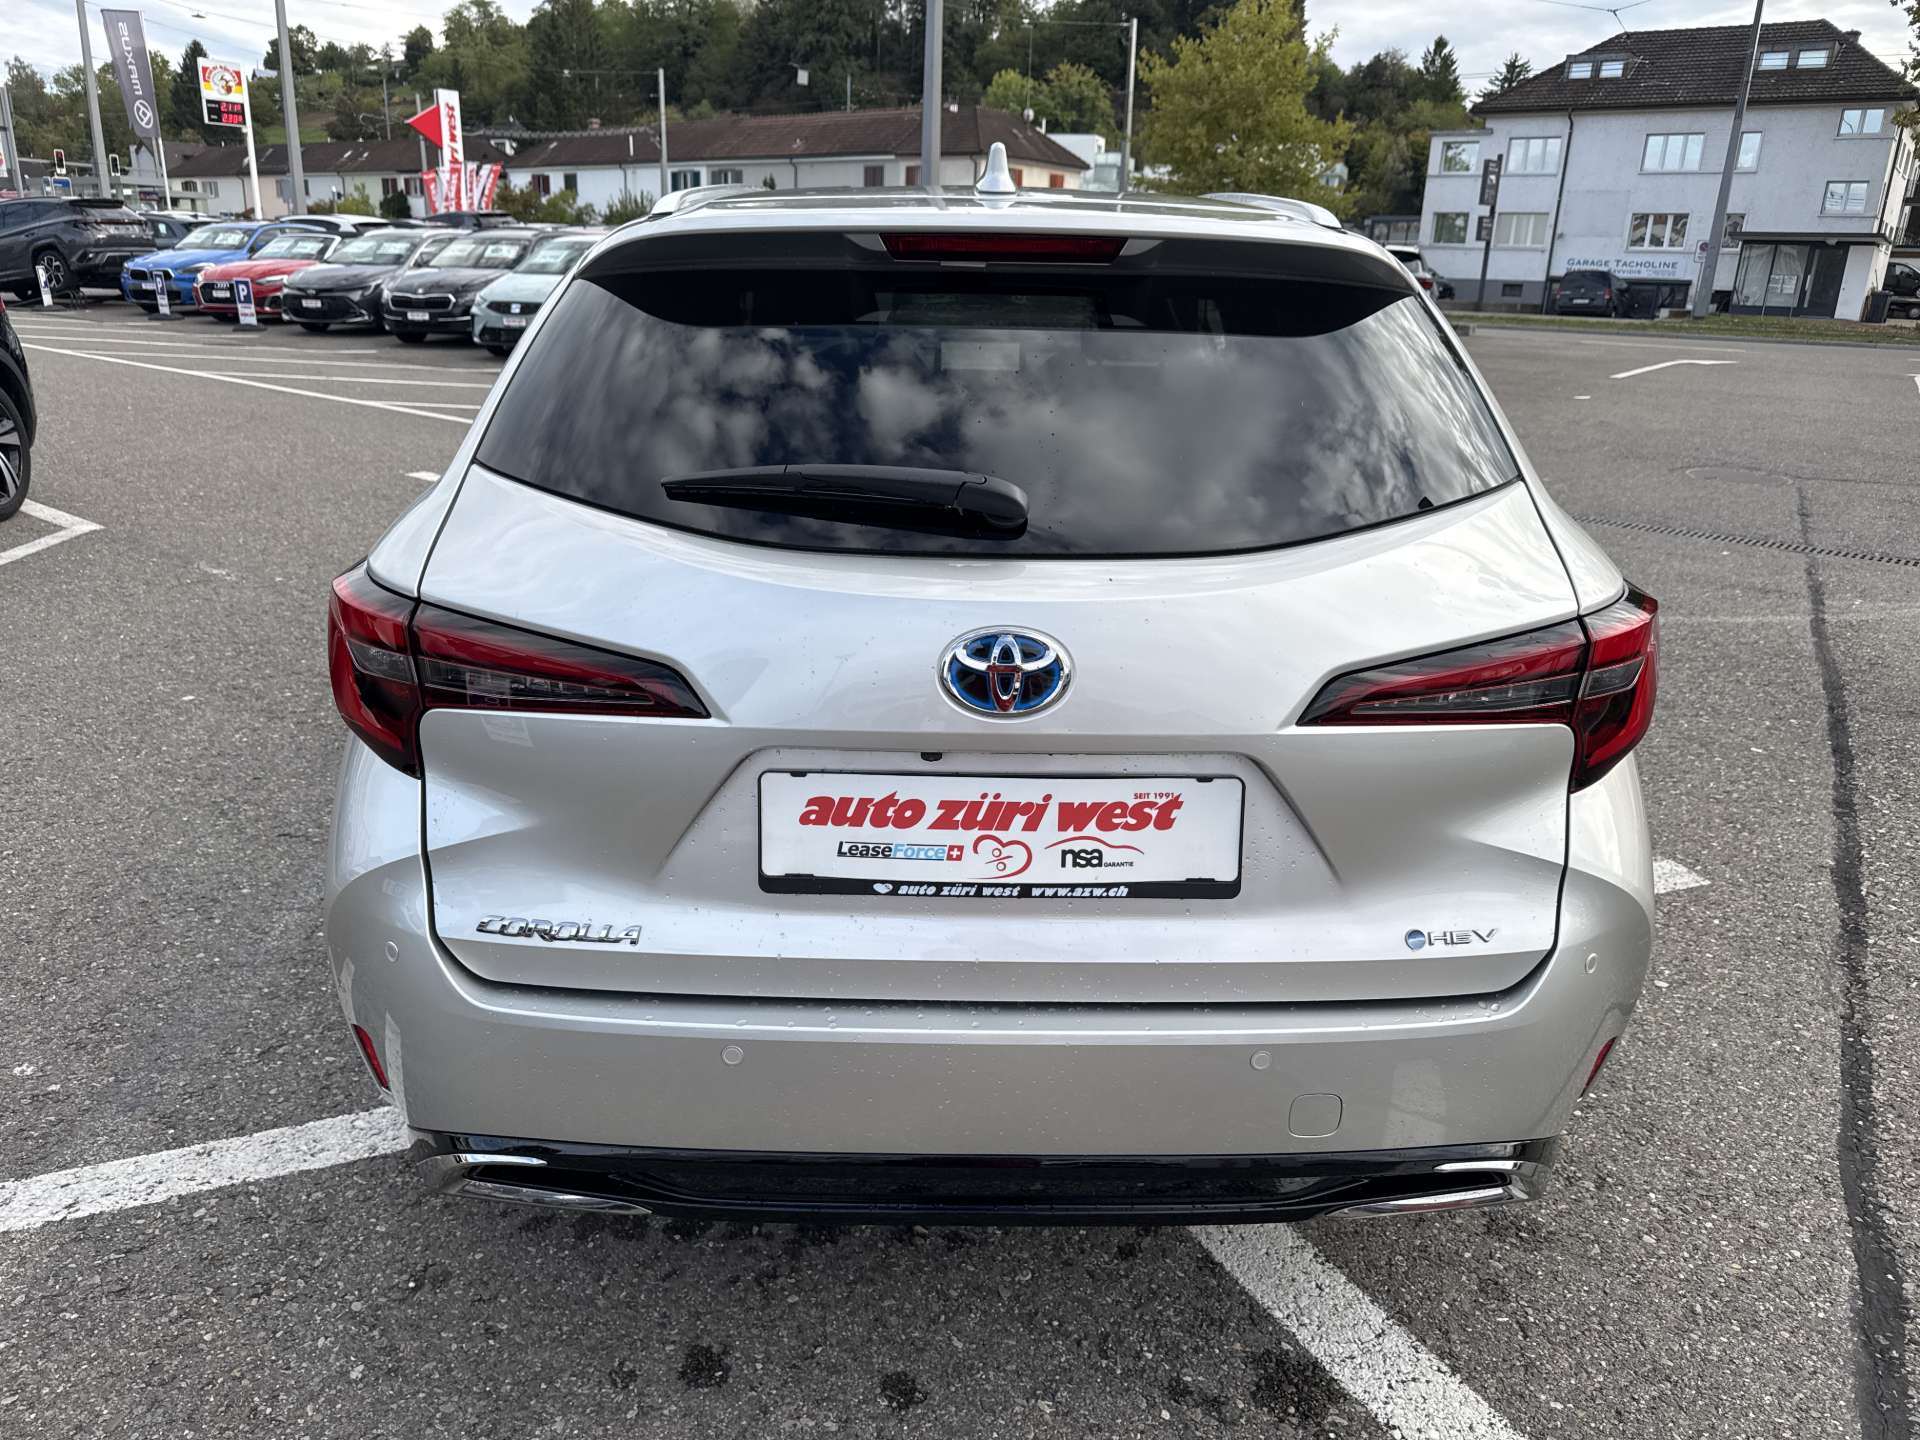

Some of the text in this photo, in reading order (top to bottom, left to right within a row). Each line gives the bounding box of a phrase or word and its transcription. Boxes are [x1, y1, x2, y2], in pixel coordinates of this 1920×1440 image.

[1567, 258, 1679, 269] GARAGE TACHOLINE
[238, 284, 248, 302] P
[1133, 792, 1175, 800] SEIT 1991
[798, 790, 1184, 832] auto züri west
[837, 841, 947, 860] LeaseForce
[1060, 848, 1103, 869] nsa
[898, 883, 1129, 898] auto züri west www.azw.ch
[476, 915, 643, 946] COROLLA
[1427, 928, 1497, 946] HEV
